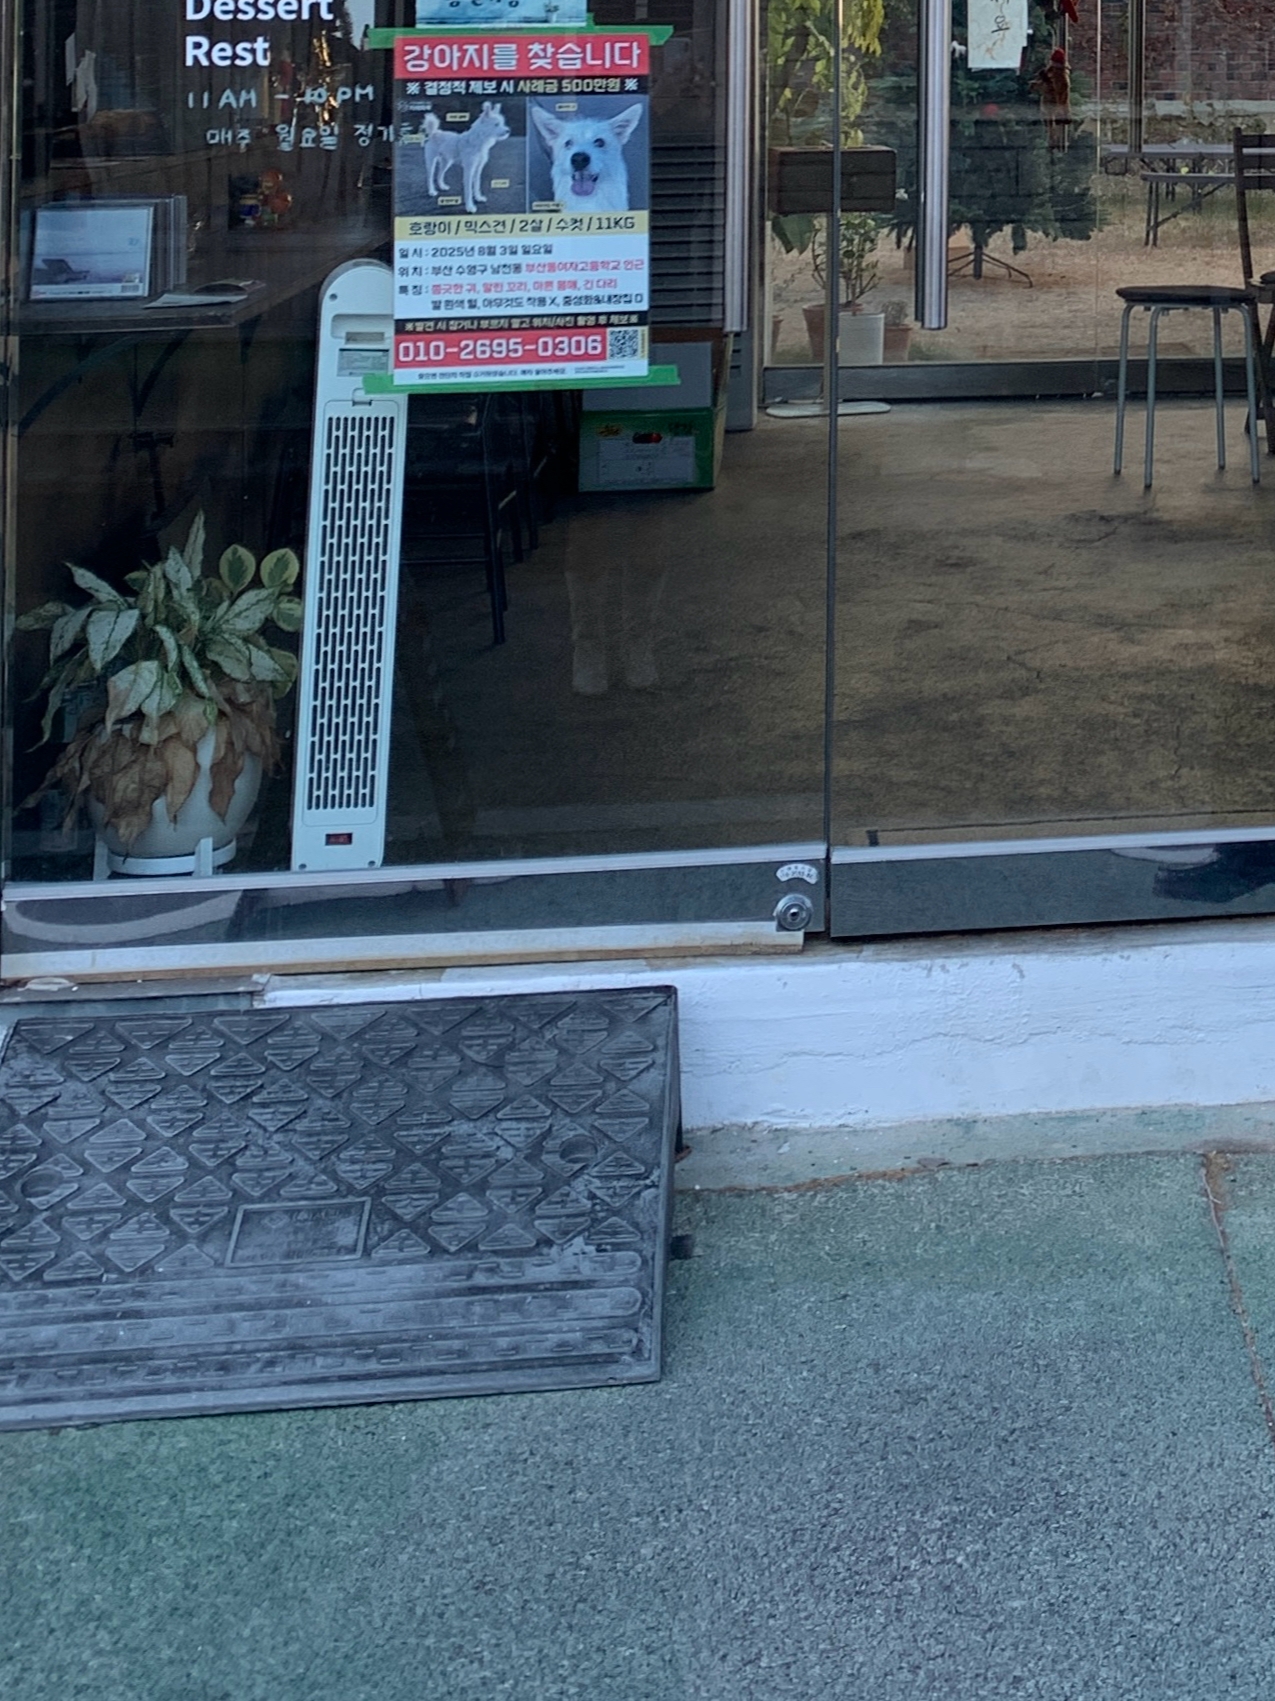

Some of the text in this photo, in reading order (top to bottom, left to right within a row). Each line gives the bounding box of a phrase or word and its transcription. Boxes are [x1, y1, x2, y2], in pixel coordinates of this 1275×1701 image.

[185, 35, 270, 67] Rest
[403, 41, 641, 72] 강아지를 찾습니다
[424, 80, 466, 95] 결정적
[468, 80, 497, 94] 제보
[501, 80, 514, 95] 시
[517, 79, 558, 94] 사례금
[562, 78, 620, 92] 500만원
[206, 126, 251, 146] 매주
[276, 124, 339, 151] 월요일
[409, 220, 451, 235] 호랑이
[464, 220, 506, 234] 믹스견
[519, 219, 543, 233] 2살
[555, 217, 583, 232] 수컷
[596, 216, 635, 230] 11KG
[431, 245, 475, 258] 2025년
[478, 245, 496, 256] 8월
[499, 244, 518, 256] 3일
[521, 243, 553, 255] 일요일
[431, 265, 453, 276] 부산
[455, 264, 487, 276] 수영구
[490, 263, 522, 275] 남천동
[623, 259, 644, 270] 인근
[398, 335, 602, 362] 010-2695-0306
